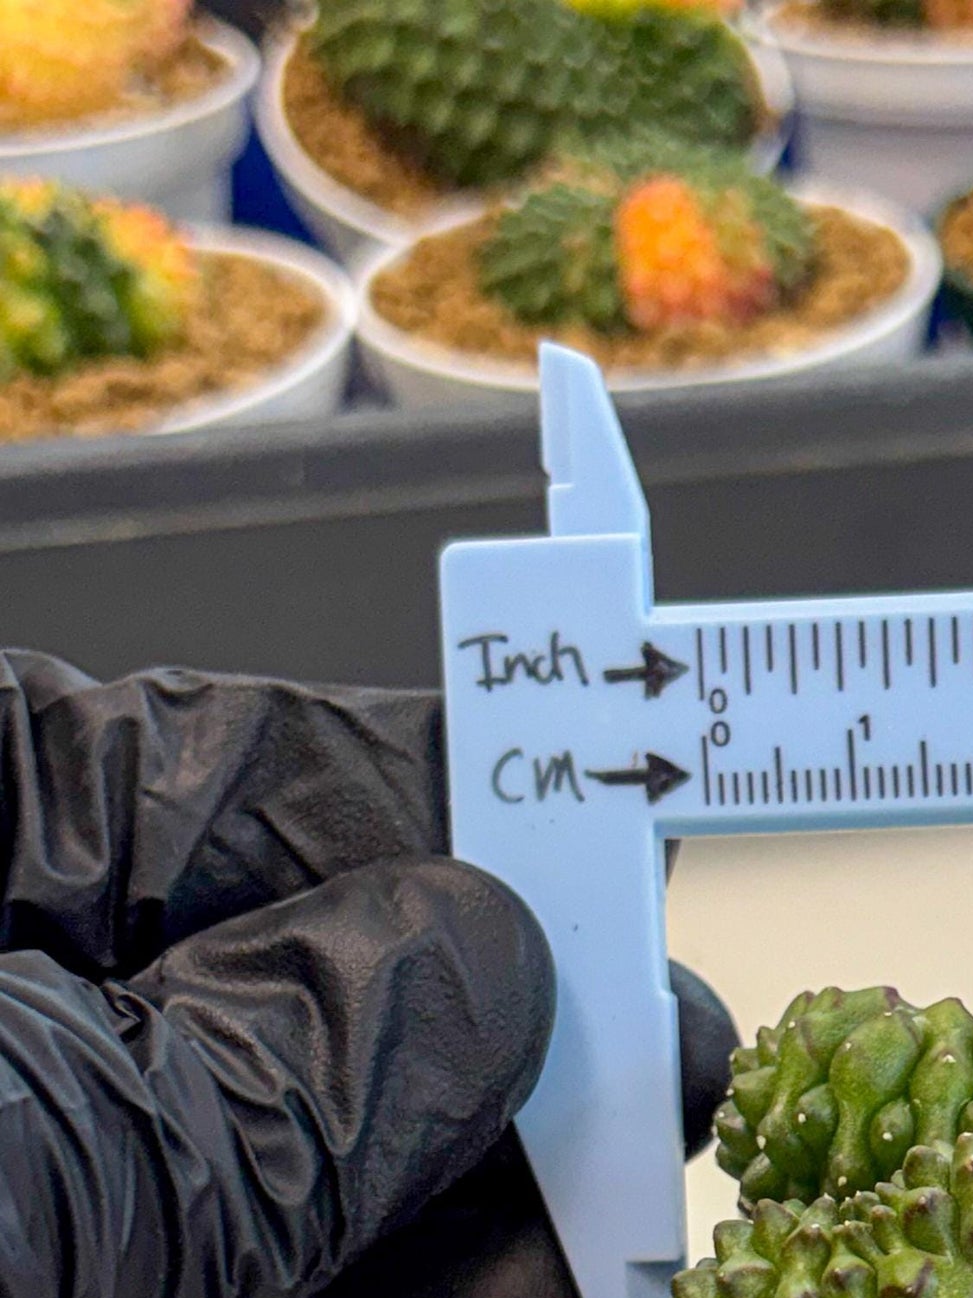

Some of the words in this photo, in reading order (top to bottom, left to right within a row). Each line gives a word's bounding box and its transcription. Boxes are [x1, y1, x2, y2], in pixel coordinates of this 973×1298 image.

[457, 631, 589, 692] Inch
[709, 688, 728, 713] 0
[710, 721, 731, 746] 0
[857, 715, 871, 741] 1
